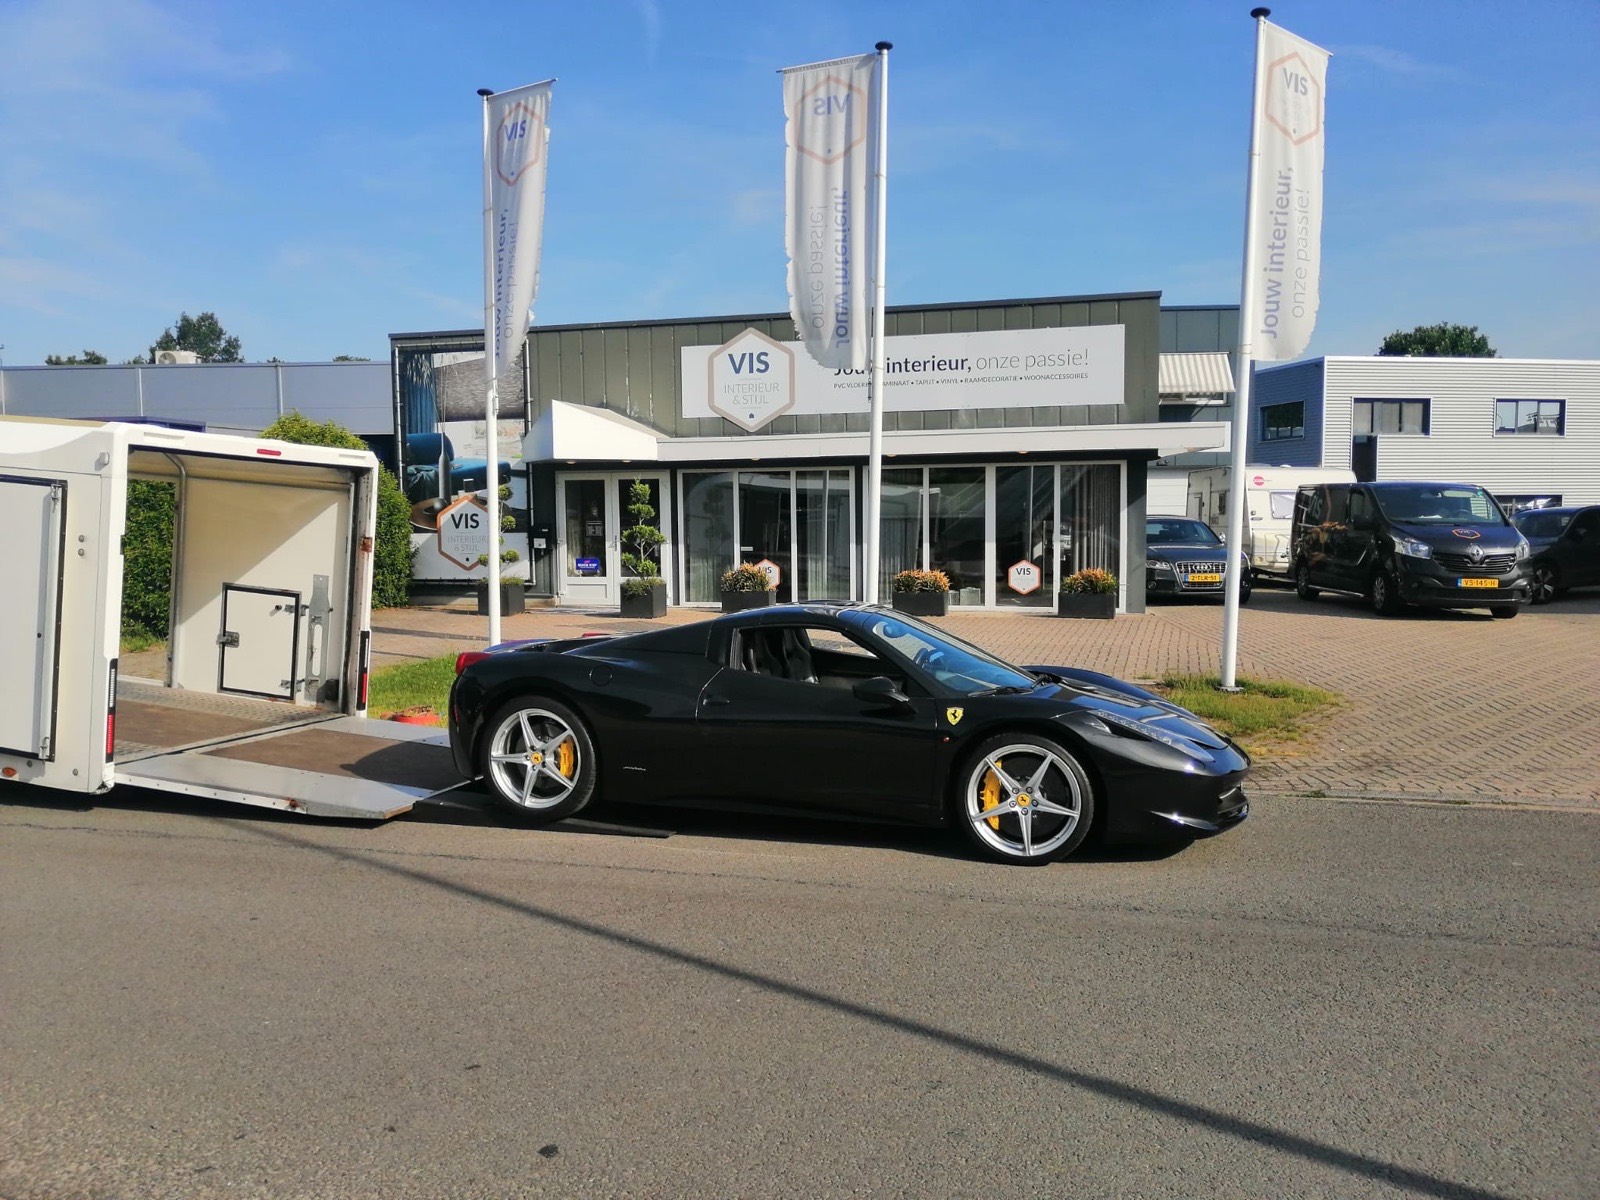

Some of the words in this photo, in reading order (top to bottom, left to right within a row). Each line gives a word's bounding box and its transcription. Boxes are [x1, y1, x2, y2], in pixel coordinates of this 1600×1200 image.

[1283, 67, 1308, 96] VIS
[504, 119, 527, 142] VIS
[1263, 165, 1293, 274] interieur,
[1294, 188, 1310, 262] passie!
[1292, 266, 1309, 319] onze
[503, 297, 515, 339] onze
[1261, 279, 1282, 339] Jouw
[728, 352, 770, 374] VIS
[886, 354, 971, 373] interieur,
[976, 355, 1020, 370] onze
[1025, 348, 1088, 371] passie!
[724, 382, 779, 394] INTERIEUR
[964, 375, 1018, 383] RAAMDECORATIE
[1023, 373, 1088, 381] WOONACCESSOIRES
[732, 395, 741, 405] &
[743, 394, 768, 405] STIJL
[451, 513, 479, 529] VIS
[447, 535, 487, 544] INTERIEUR
[1015, 567, 1031, 575] VIS
